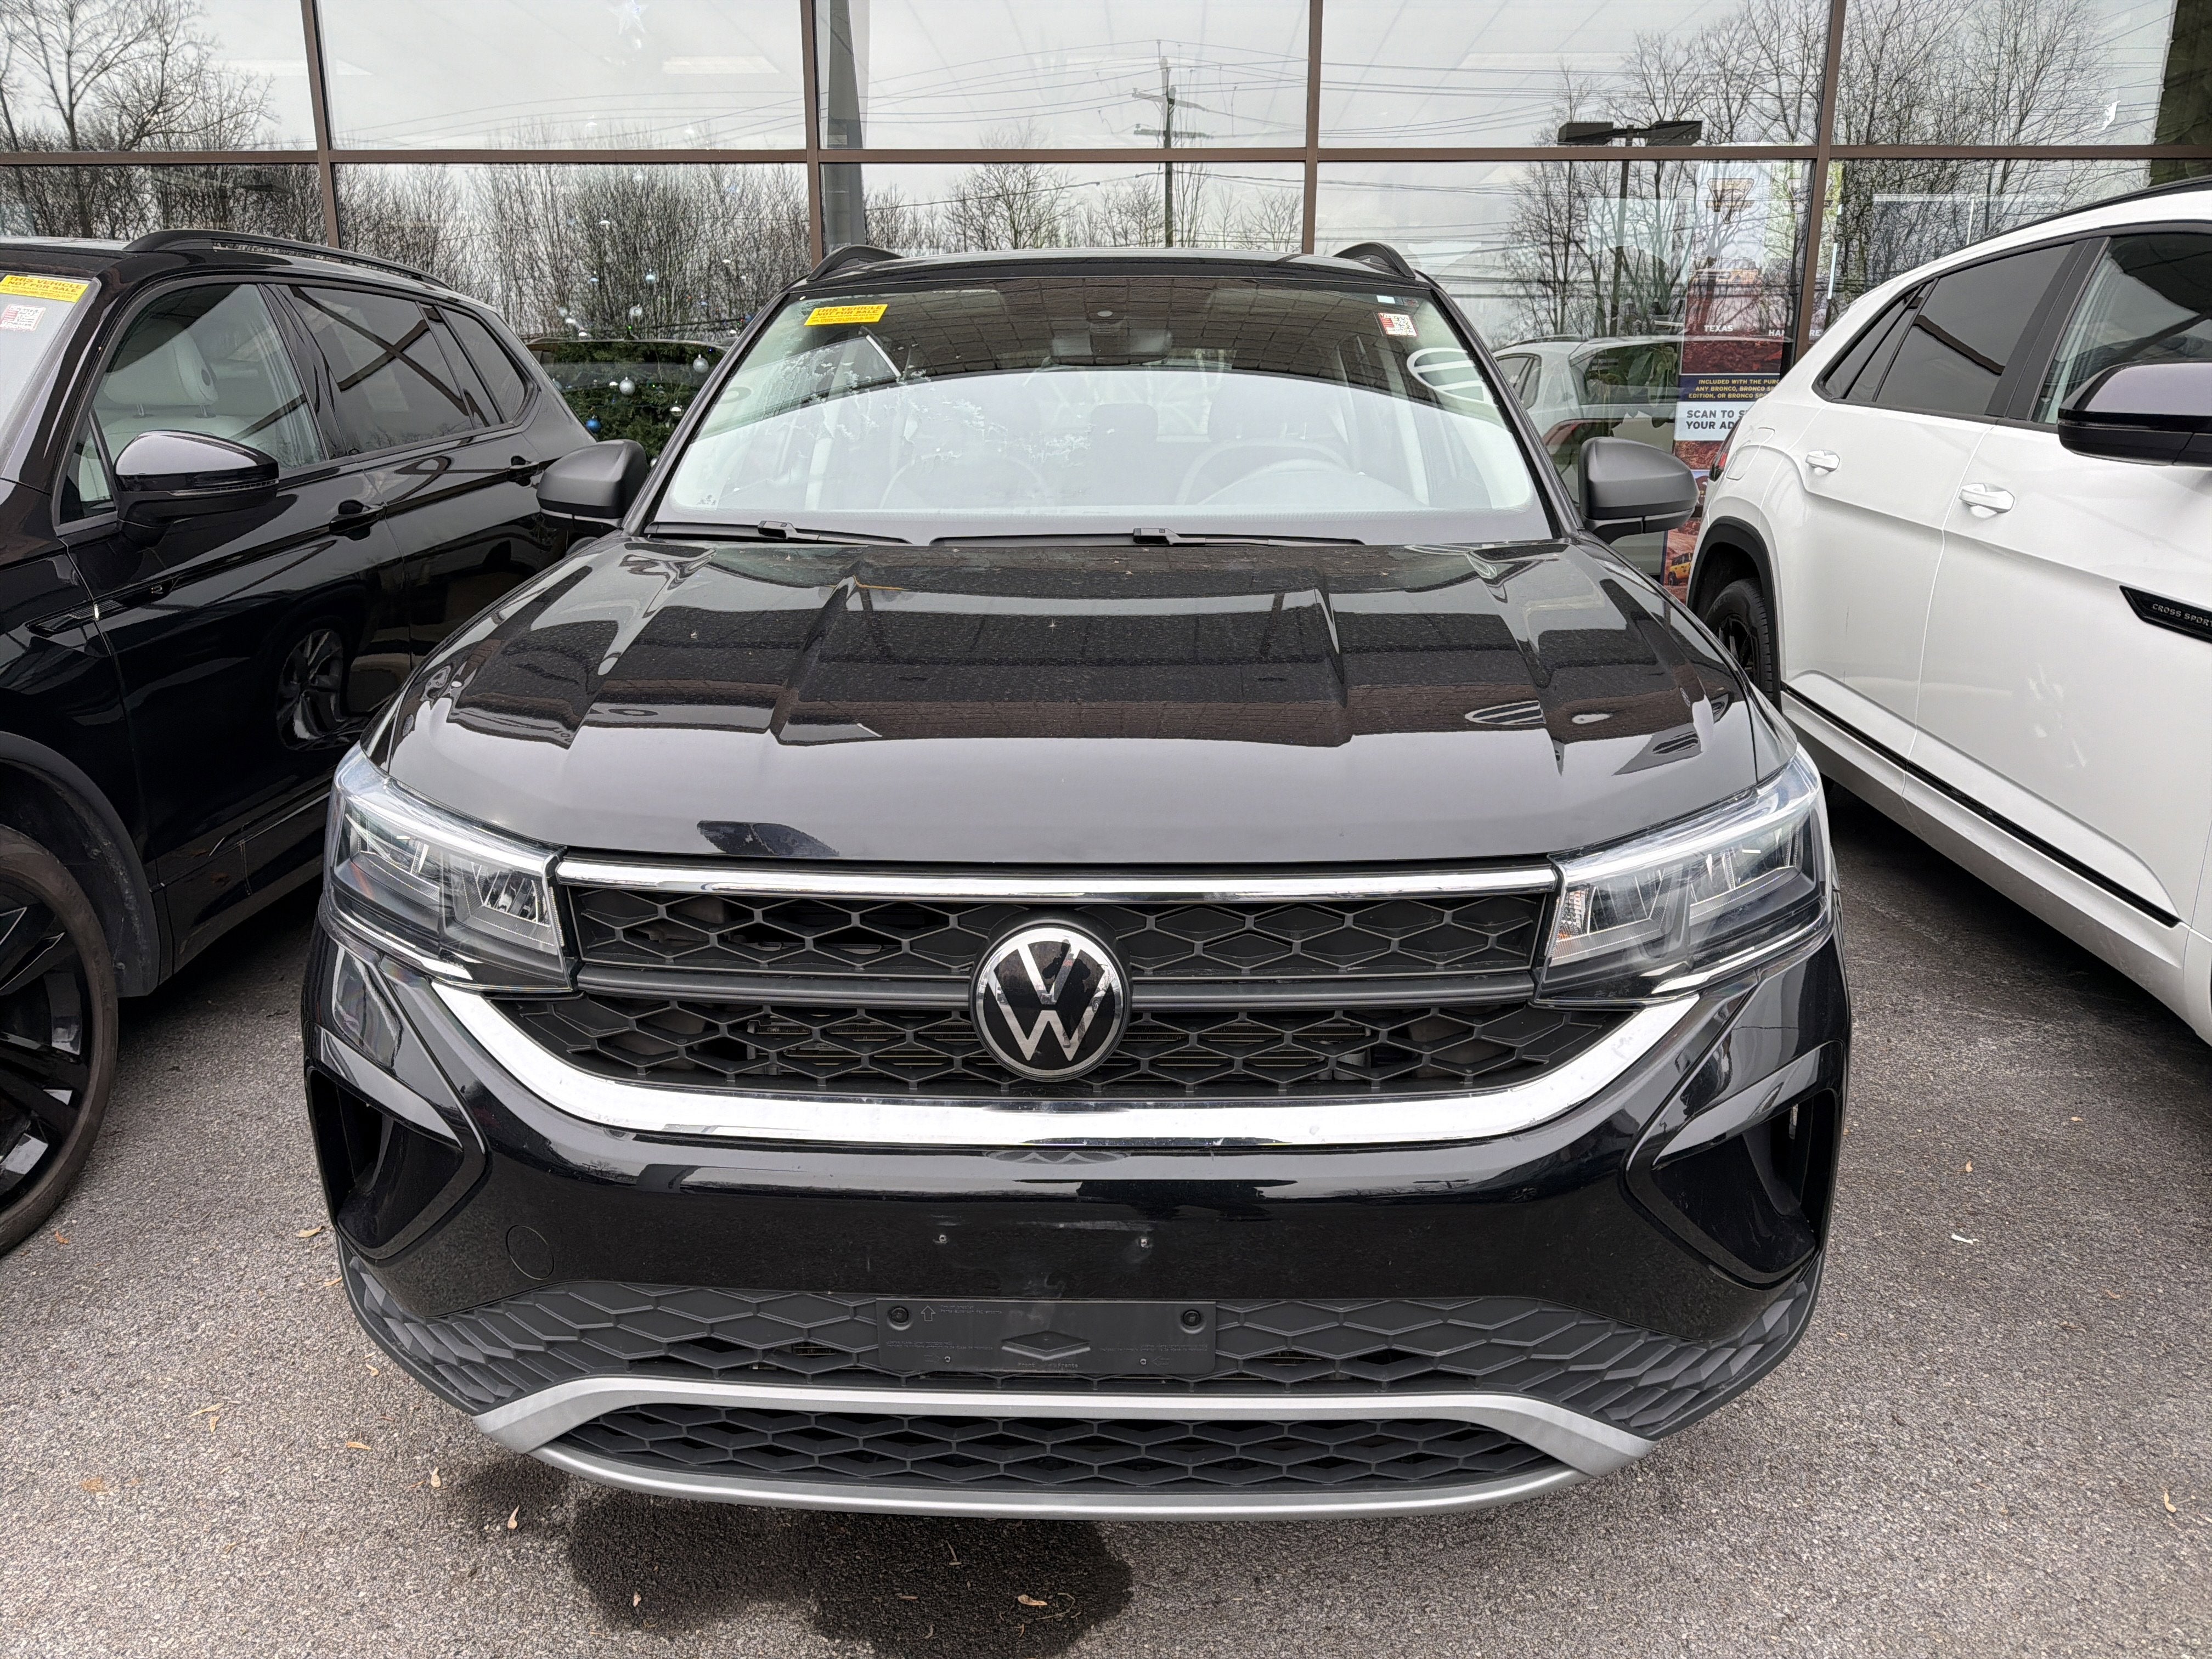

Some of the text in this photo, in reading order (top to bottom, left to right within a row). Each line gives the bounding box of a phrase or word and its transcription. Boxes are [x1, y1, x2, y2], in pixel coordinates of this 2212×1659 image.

[37, 279, 82, 289] VEHICLE
[1686, 410, 1748, 418] SCAN TO S
[1686, 421, 1716, 430] YOUR
[2152, 603, 2182, 617] CROSS
[985, 935, 1115, 1063] VW
